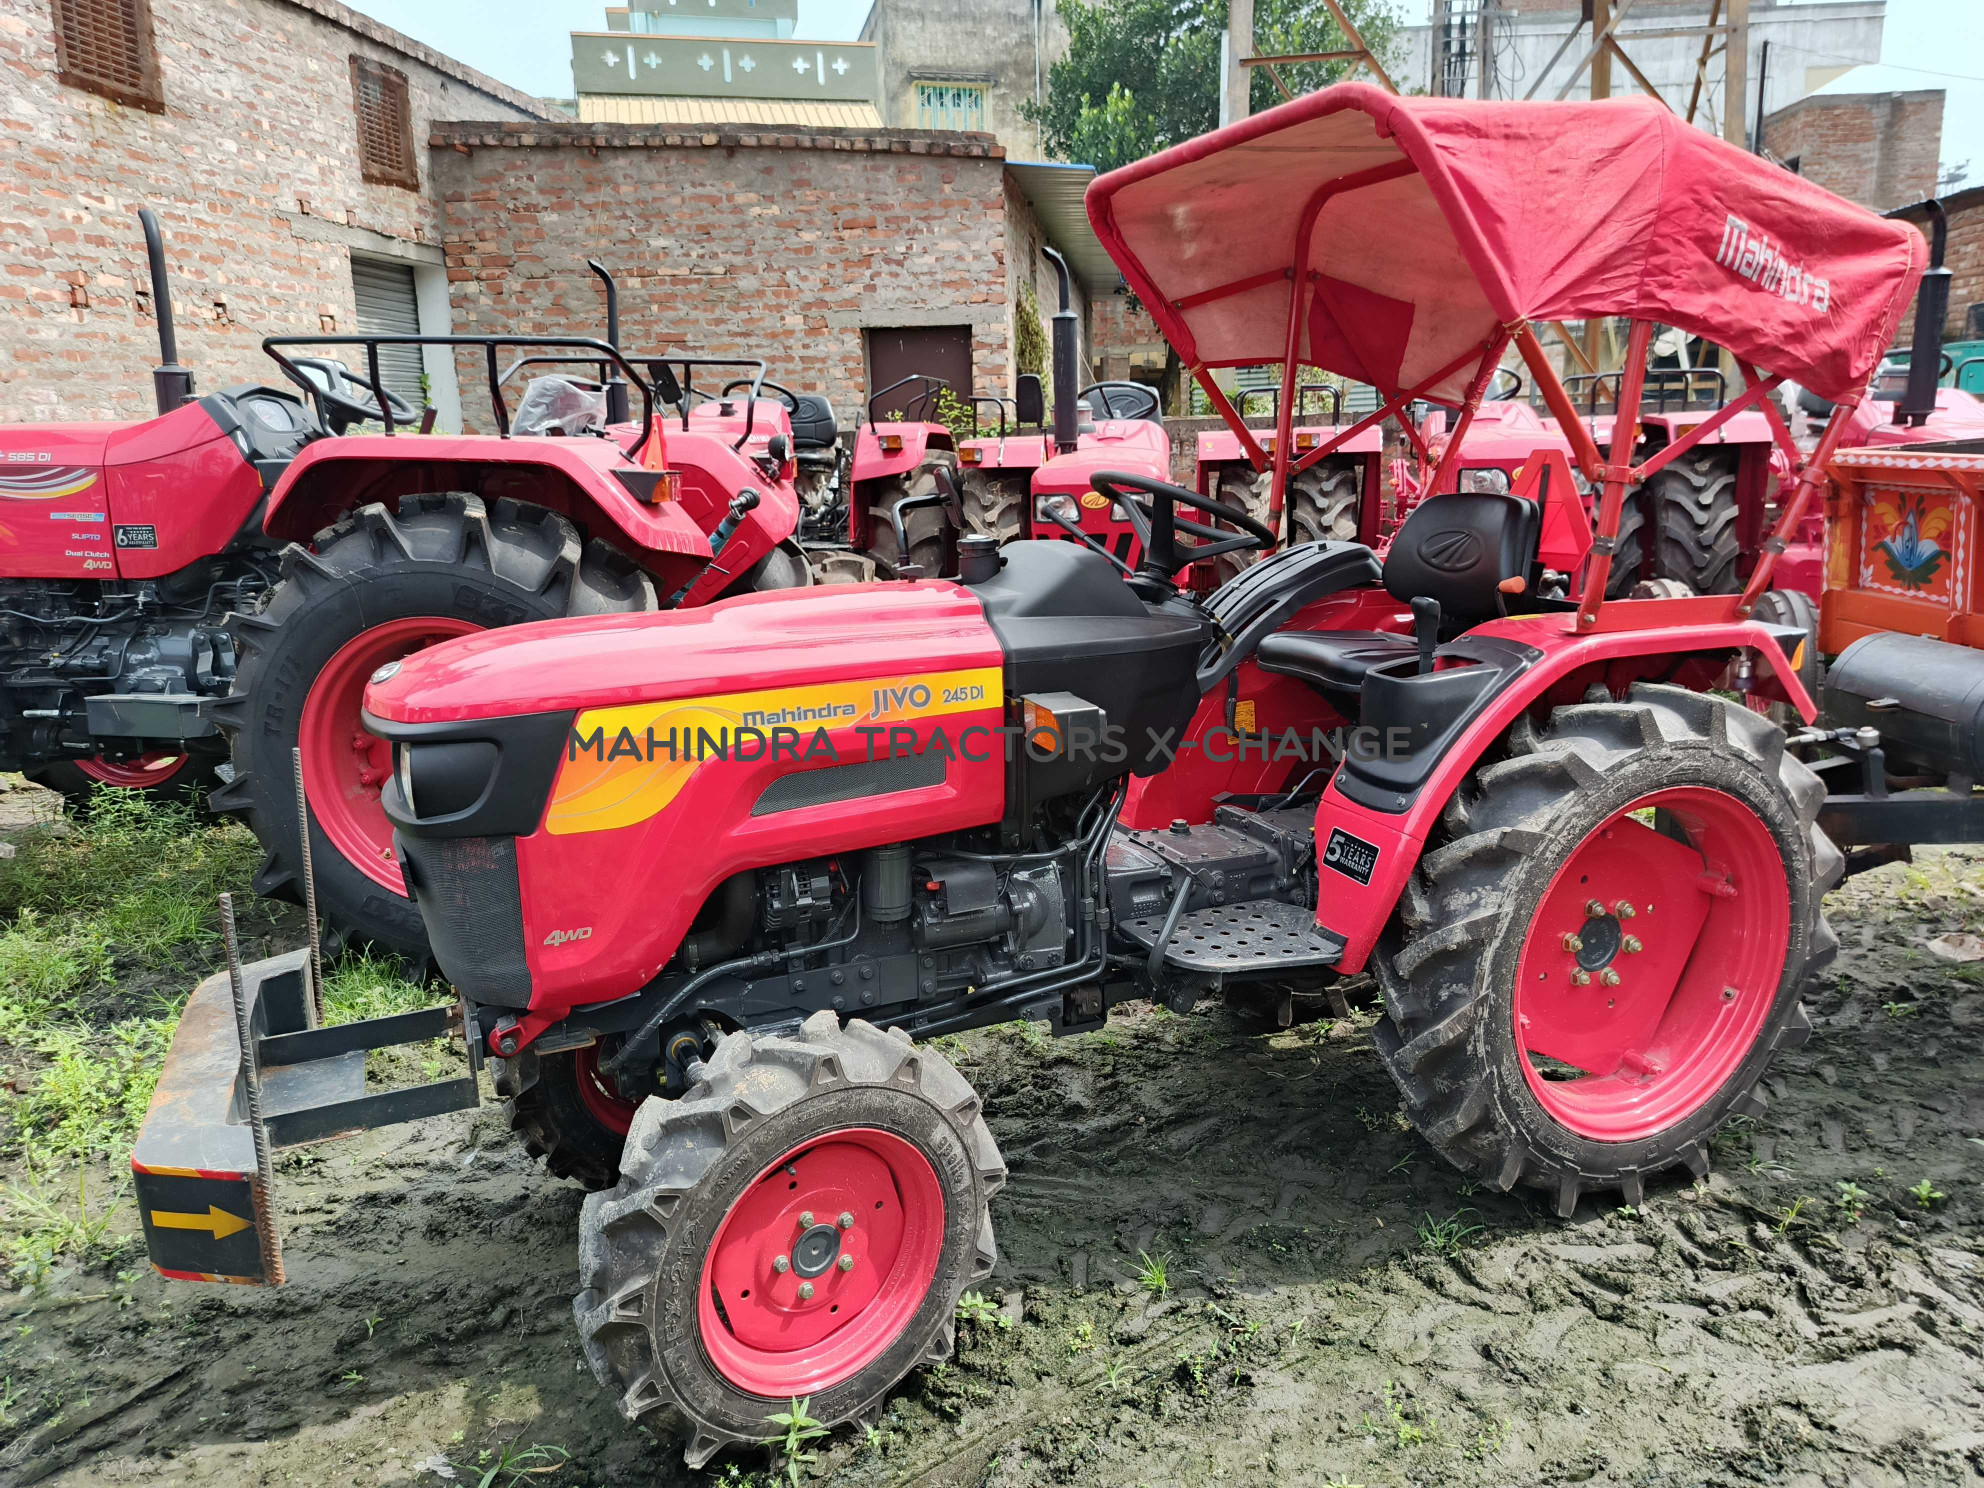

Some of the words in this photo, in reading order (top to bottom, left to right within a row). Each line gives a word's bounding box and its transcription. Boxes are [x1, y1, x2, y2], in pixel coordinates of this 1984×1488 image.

[1716, 214, 1830, 313] Mahindra
[8, 452, 36, 462] 585
[38, 452, 52, 462] DI
[117, 528, 129, 546] 6
[127, 533, 155, 541] YEARS
[65, 549, 84, 557] Dual
[84, 550, 110, 558] Clutch
[83, 558, 113, 571] 4WD
[456, 585, 528, 625] BKT
[743, 701, 857, 727] Mahindra
[869, 683, 932, 720] JIVO
[942, 687, 969, 704] 245
[969, 684, 985, 701] DI
[1325, 833, 1346, 862] 5
[1342, 844, 1372, 869] YEARS
[1339, 855, 1370, 876] WARRANTY
[543, 926, 593, 947] 4WD
[937, 1134, 966, 1185] apollo
